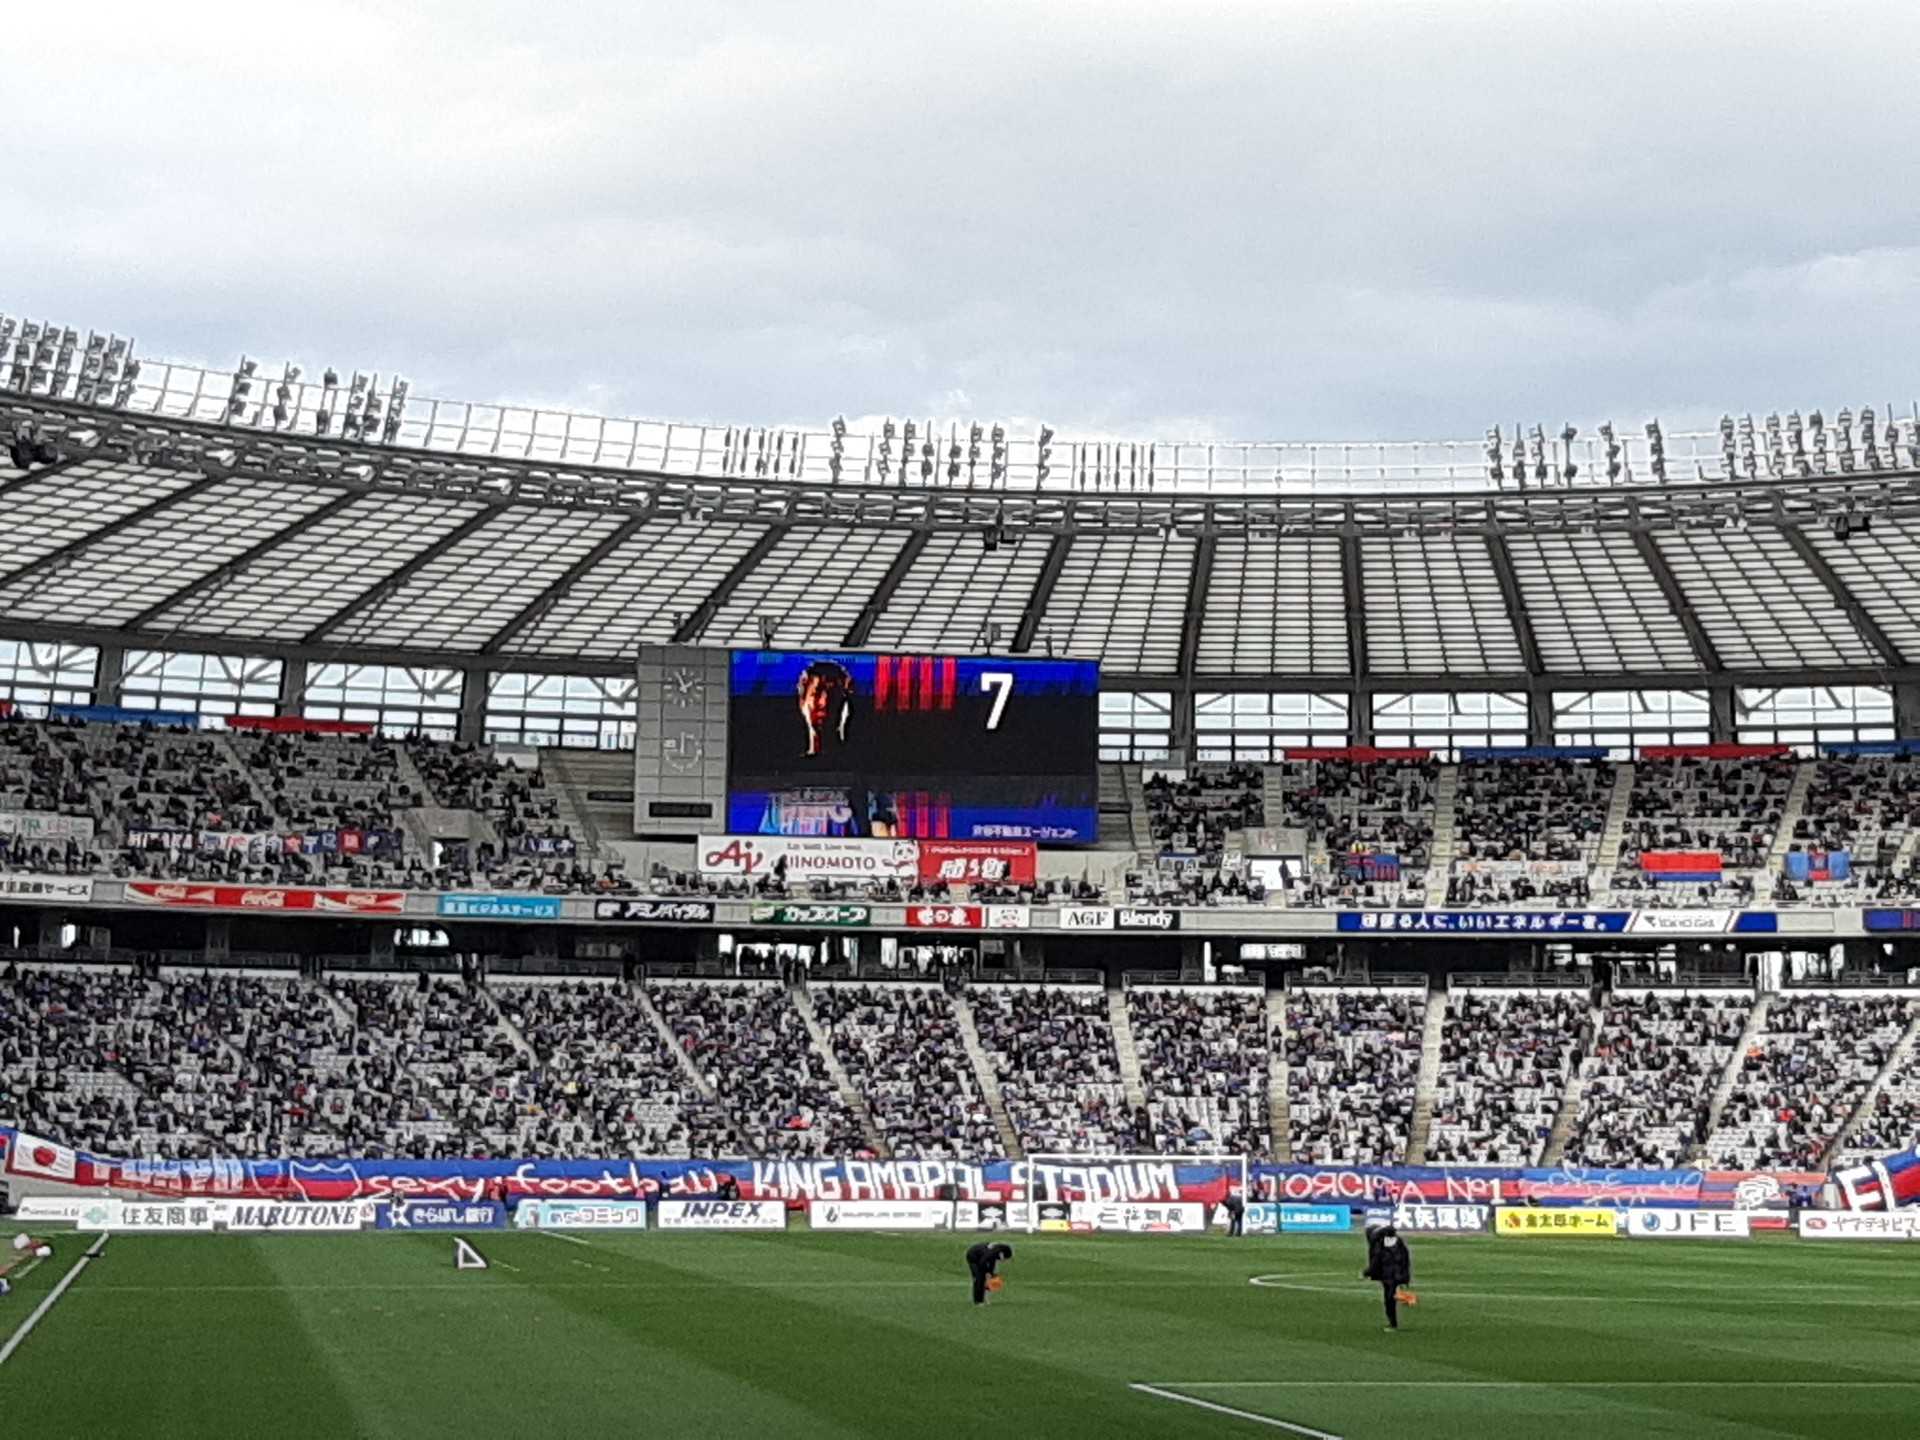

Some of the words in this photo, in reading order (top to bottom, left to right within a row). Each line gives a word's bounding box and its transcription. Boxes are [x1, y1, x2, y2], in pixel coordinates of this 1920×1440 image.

[980, 671, 1014, 730] 7
[1068, 911, 1108, 926] AGF
[1120, 909, 1172, 929] Blendy
[753, 1160, 843, 1199] KING
[681, 1202, 762, 1218] INPEX
[1665, 1213, 1736, 1232] JFE
